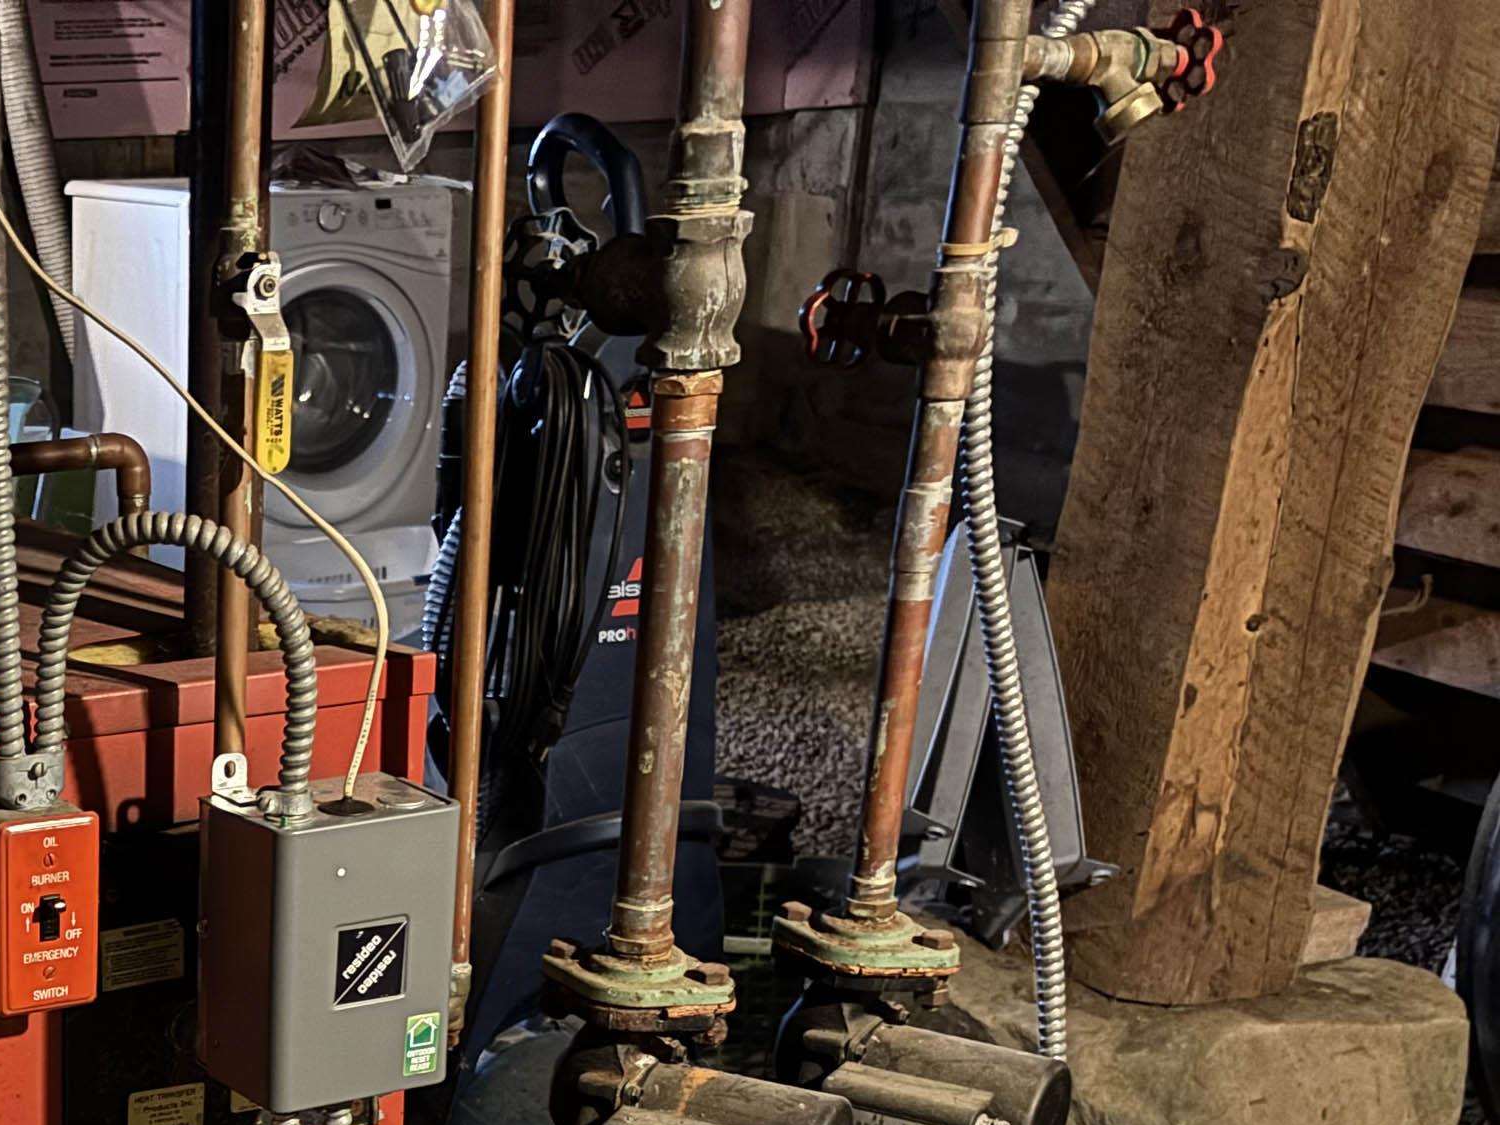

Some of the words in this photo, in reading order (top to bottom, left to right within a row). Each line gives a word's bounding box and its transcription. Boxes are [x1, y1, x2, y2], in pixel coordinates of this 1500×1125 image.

[275, 398, 284, 436] WATTS
[43, 837, 58, 848] OIL
[31, 870, 70, 887] BURNER
[20, 902, 35, 914] ON
[65, 928, 83, 941] OFF
[23, 946, 79, 965] EMERGENCY
[342, 934, 382, 980] resideo
[356, 949, 397, 995] resideo
[33, 985, 69, 1001] SWITCH
